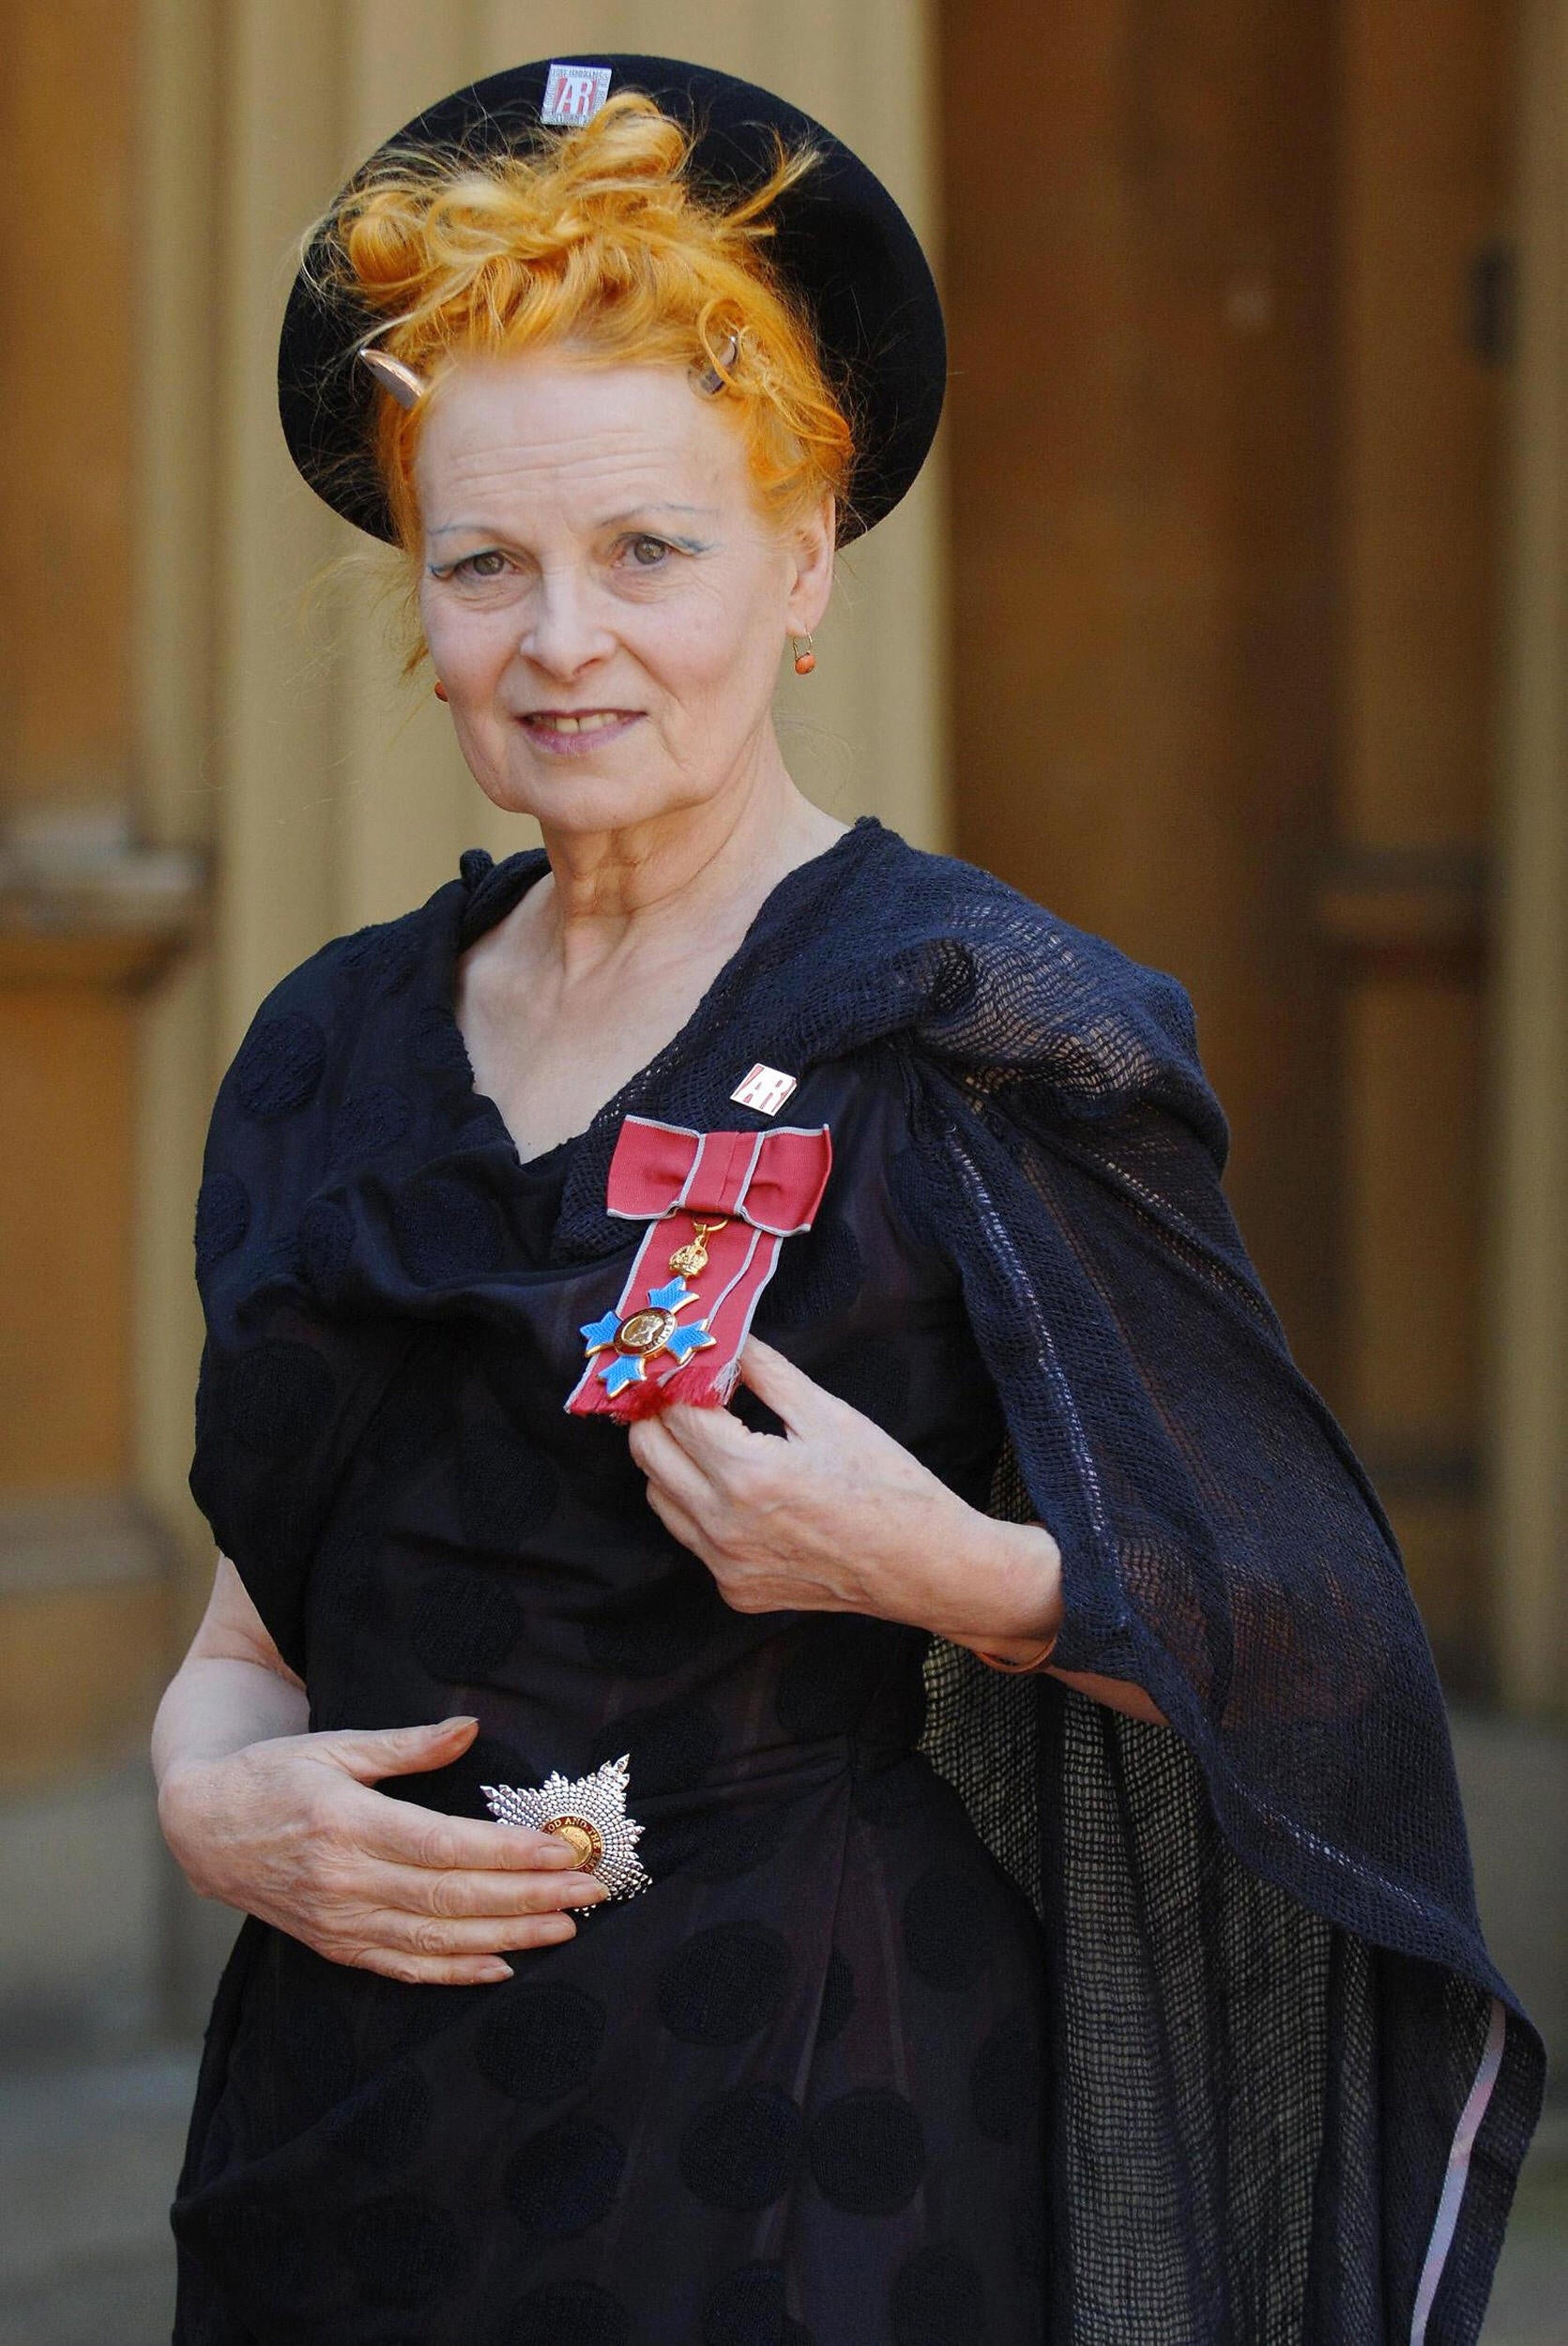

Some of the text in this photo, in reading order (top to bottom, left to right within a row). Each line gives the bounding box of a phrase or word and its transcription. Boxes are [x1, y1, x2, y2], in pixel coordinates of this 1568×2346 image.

[556, 76, 594, 115] AR
[543, 1820, 562, 1834] OD
[565, 1817, 587, 1828] AND
[588, 1827, 601, 1849] THE
